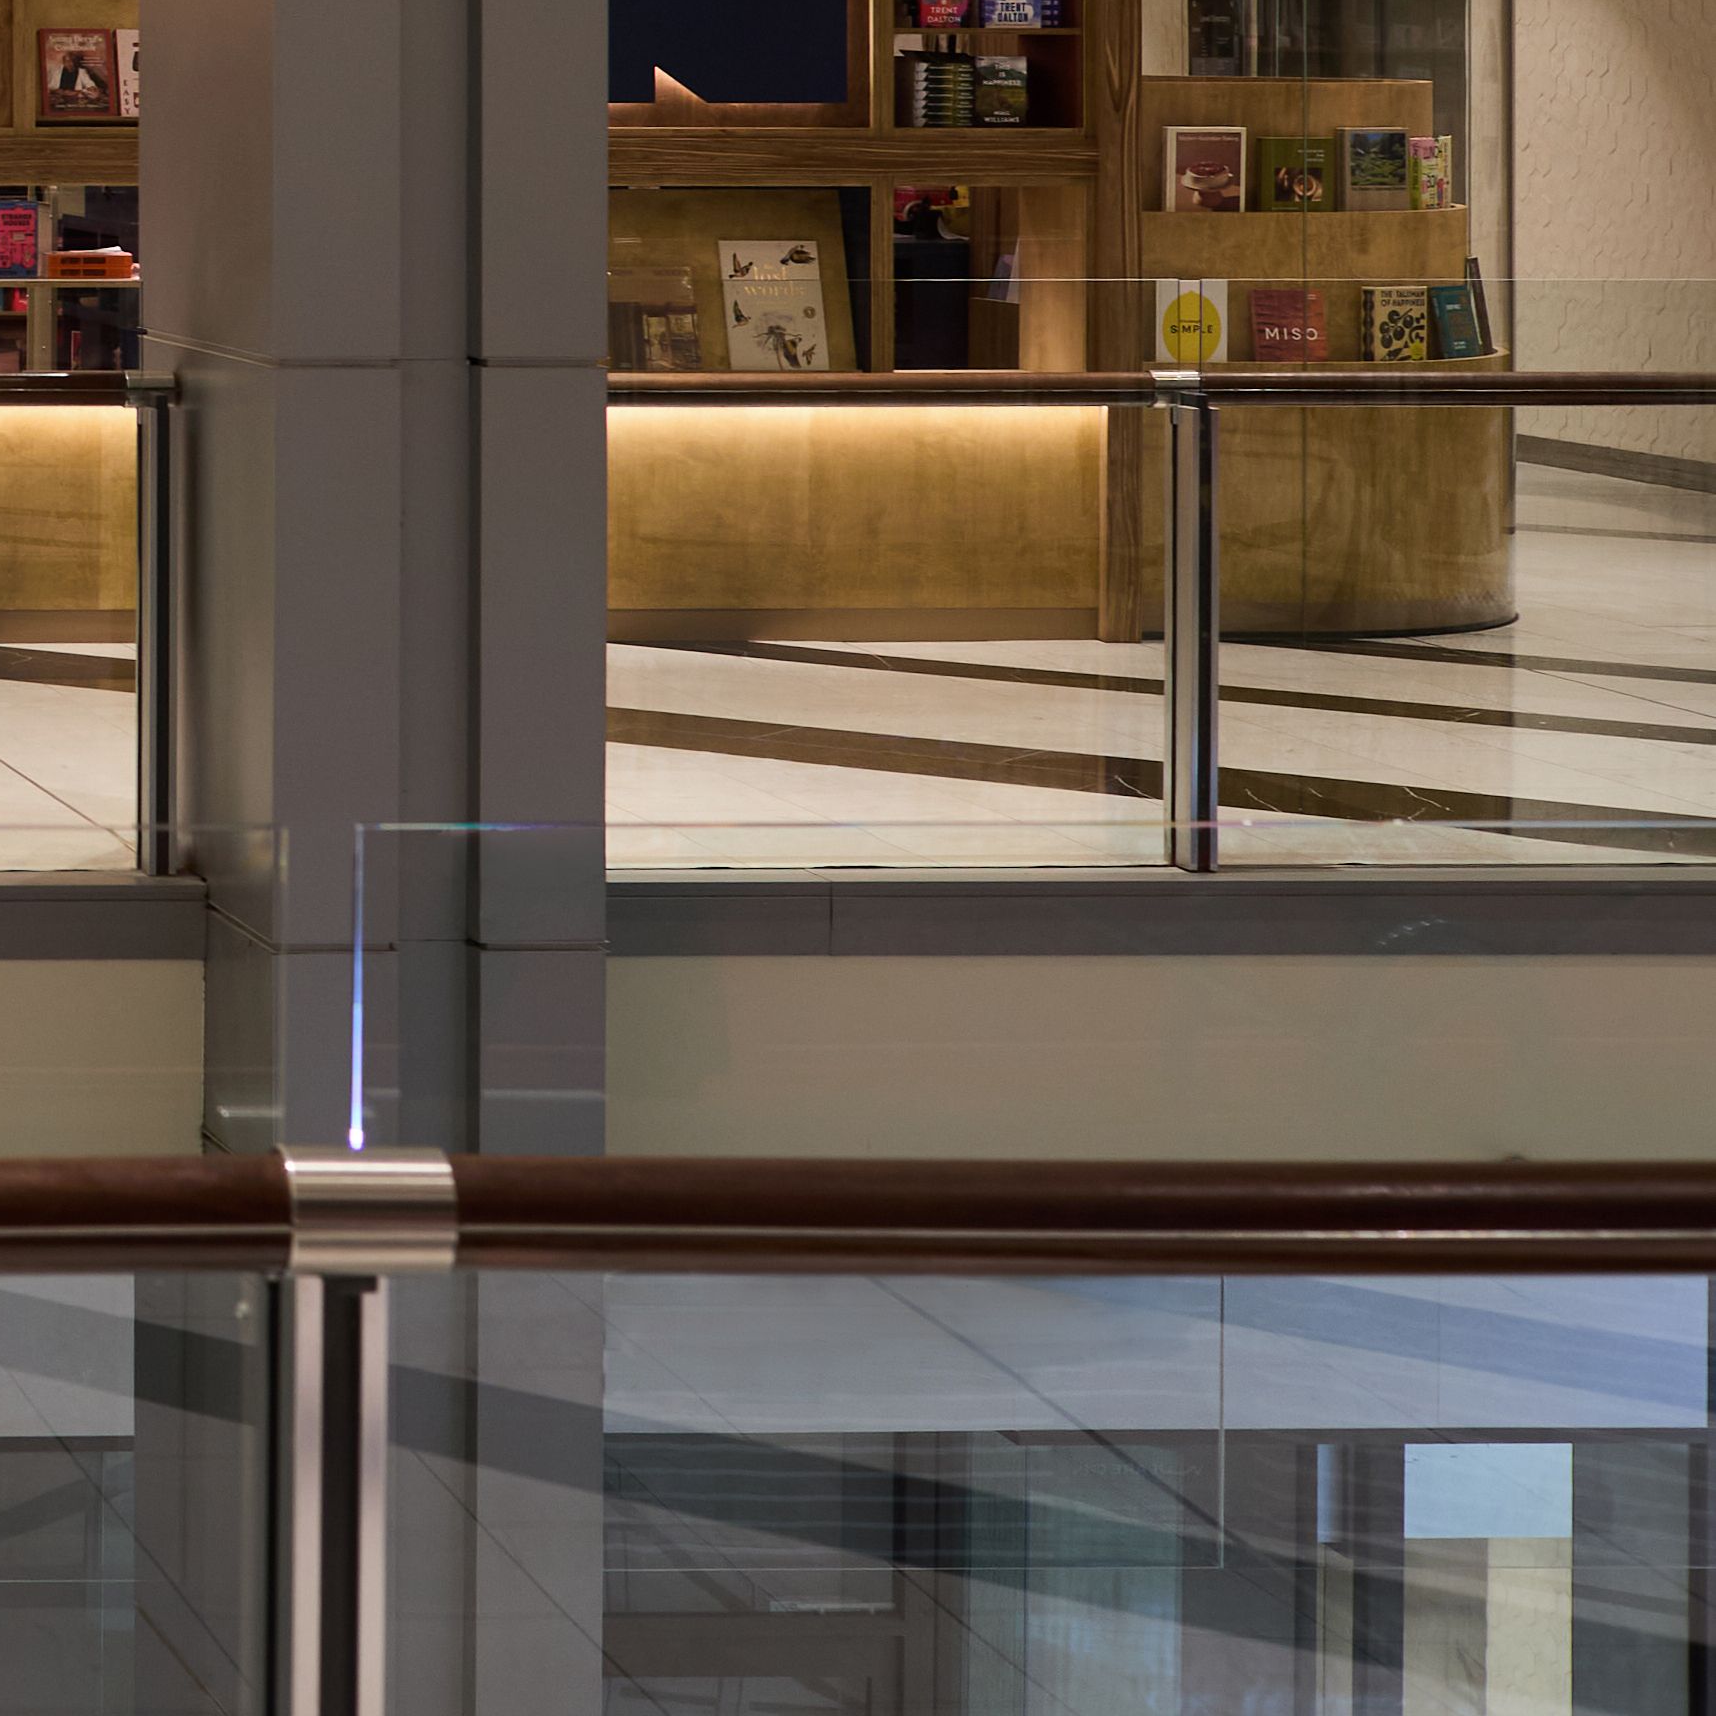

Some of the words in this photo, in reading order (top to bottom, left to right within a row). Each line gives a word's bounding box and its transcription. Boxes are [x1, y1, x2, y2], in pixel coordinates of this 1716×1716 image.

[930, 6, 958, 14] TRENT
[1000, 2, 1026, 12] TRENT
[927, 15, 961, 23] DALTON
[997, 12, 1029, 22] DALTON
[753, 266, 787, 281] lost
[744, 281, 804, 296] words
[1381, 290, 1392, 298] THE
[1170, 324, 1214, 334] SMPE
[1265, 327, 1318, 341] MISO
